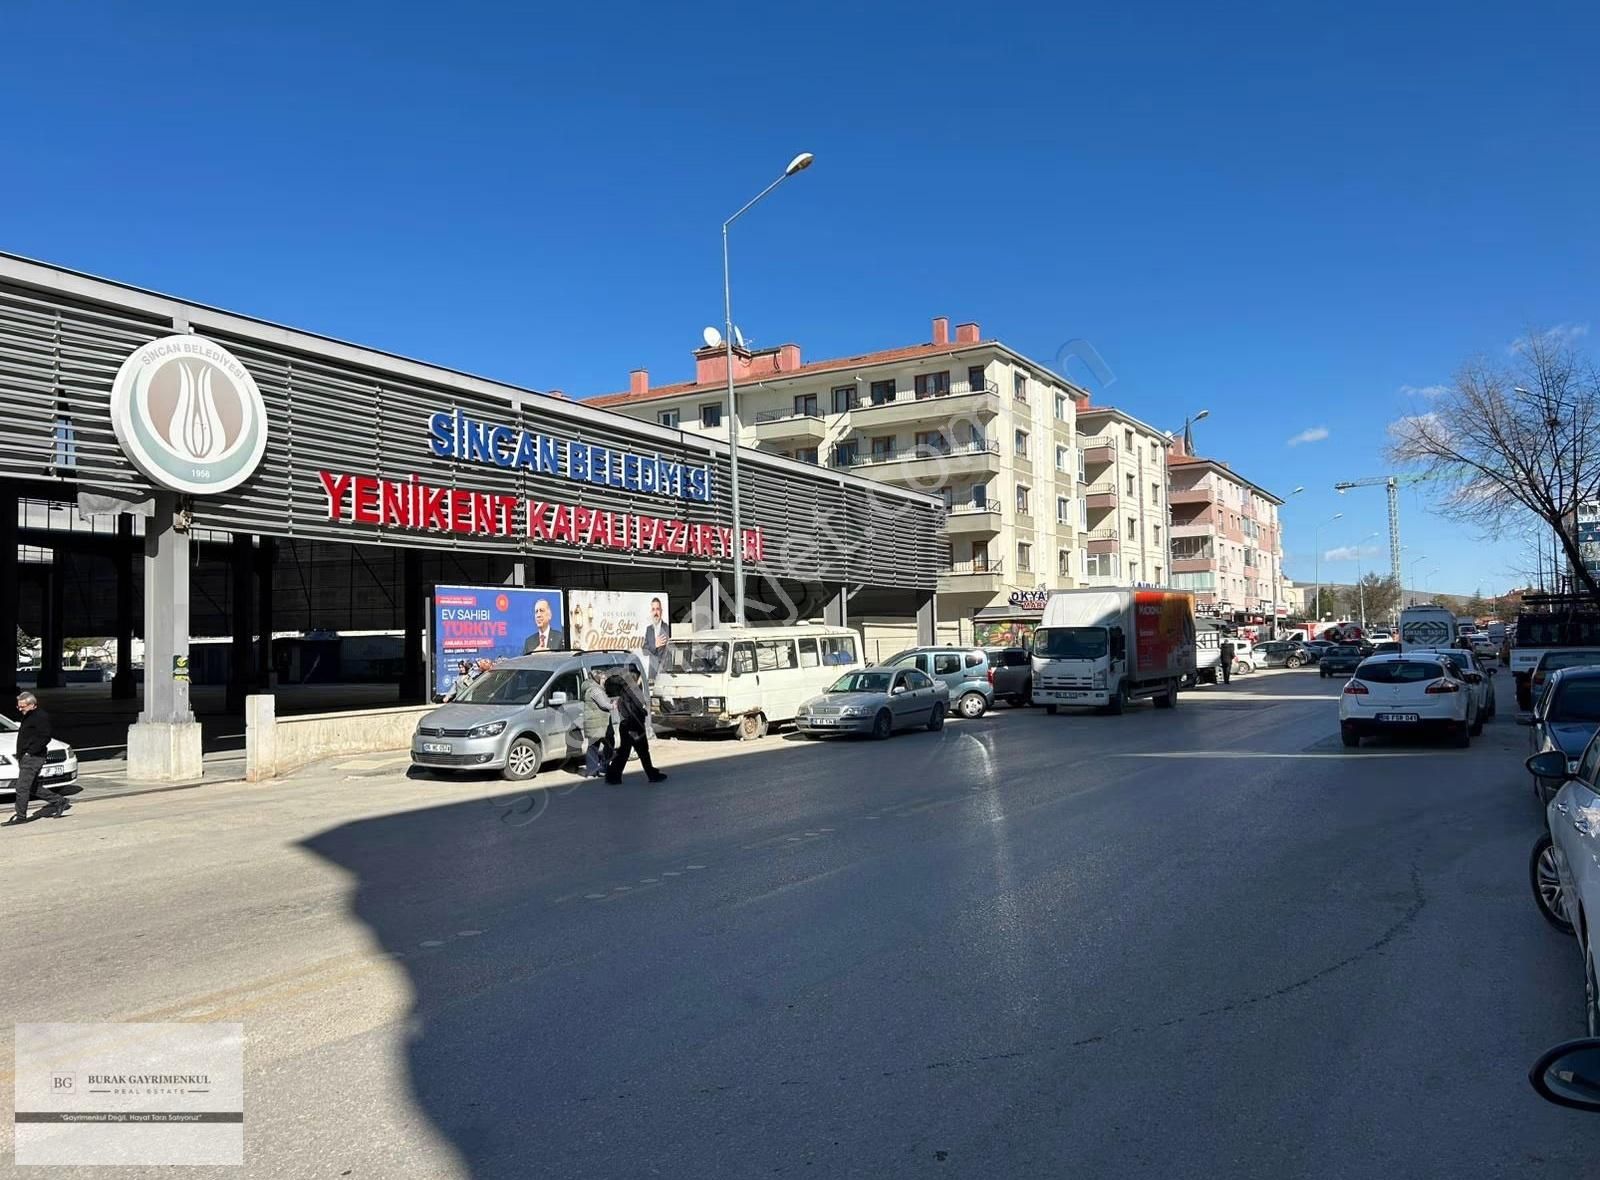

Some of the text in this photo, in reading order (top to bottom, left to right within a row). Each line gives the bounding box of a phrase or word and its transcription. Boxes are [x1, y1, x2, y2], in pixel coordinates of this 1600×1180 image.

[142, 343, 246, 380] SİNCAN BELEDİYESİ
[428, 409, 713, 502] SİNCAN BELEDİYESİ
[319, 470, 765, 561] YENİKENT KAPALI PAZAR YRİ
[442, 609, 455, 620] EV
